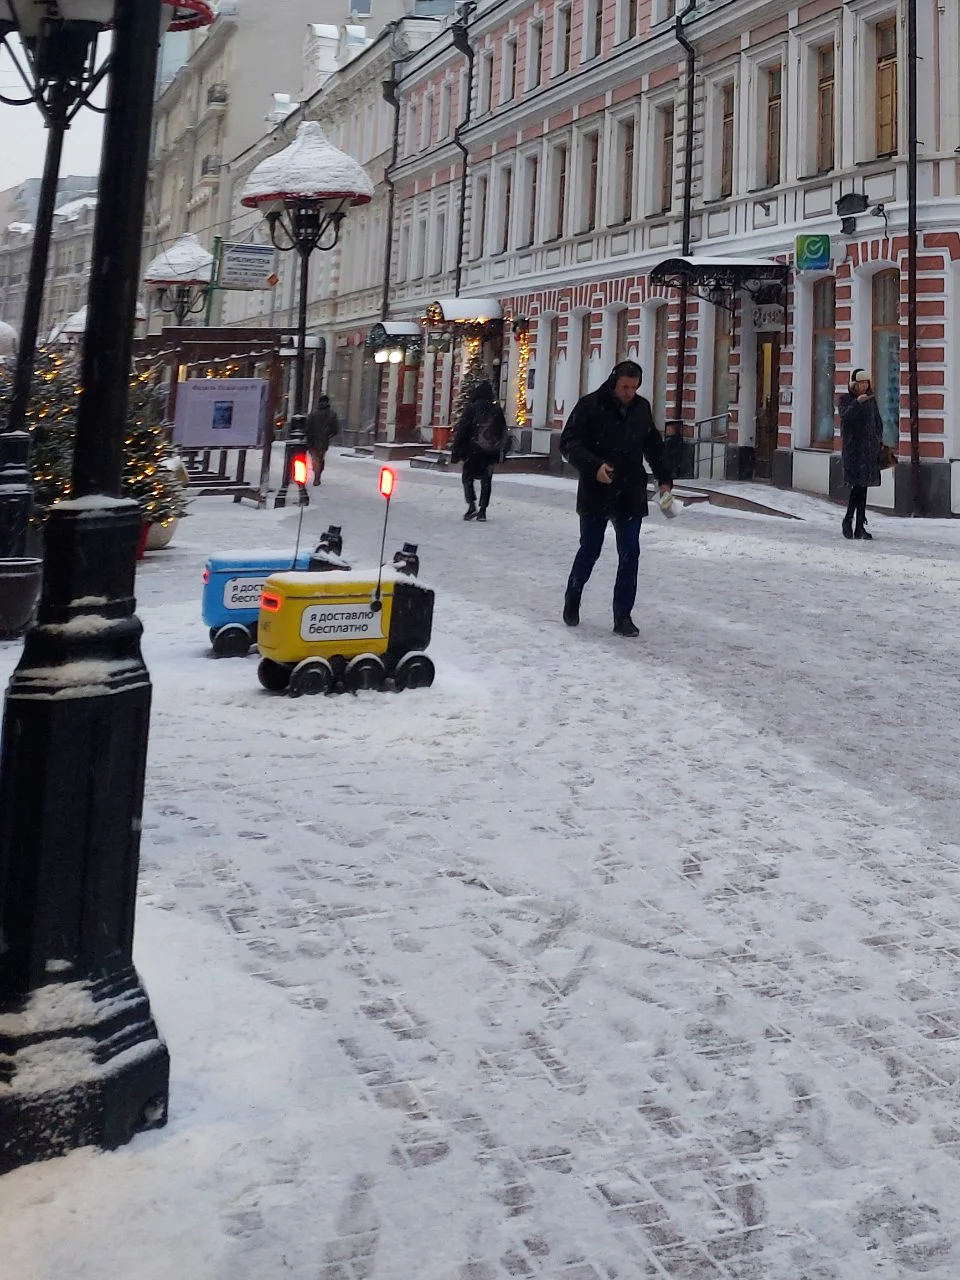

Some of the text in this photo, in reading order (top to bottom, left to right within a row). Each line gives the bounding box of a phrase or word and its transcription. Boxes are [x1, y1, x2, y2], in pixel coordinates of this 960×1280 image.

[240, 584, 265, 593] дост
[231, 593, 262, 603] беспл
[310, 611, 375, 623] я доставлю
[309, 623, 369, 634] бесплатно
